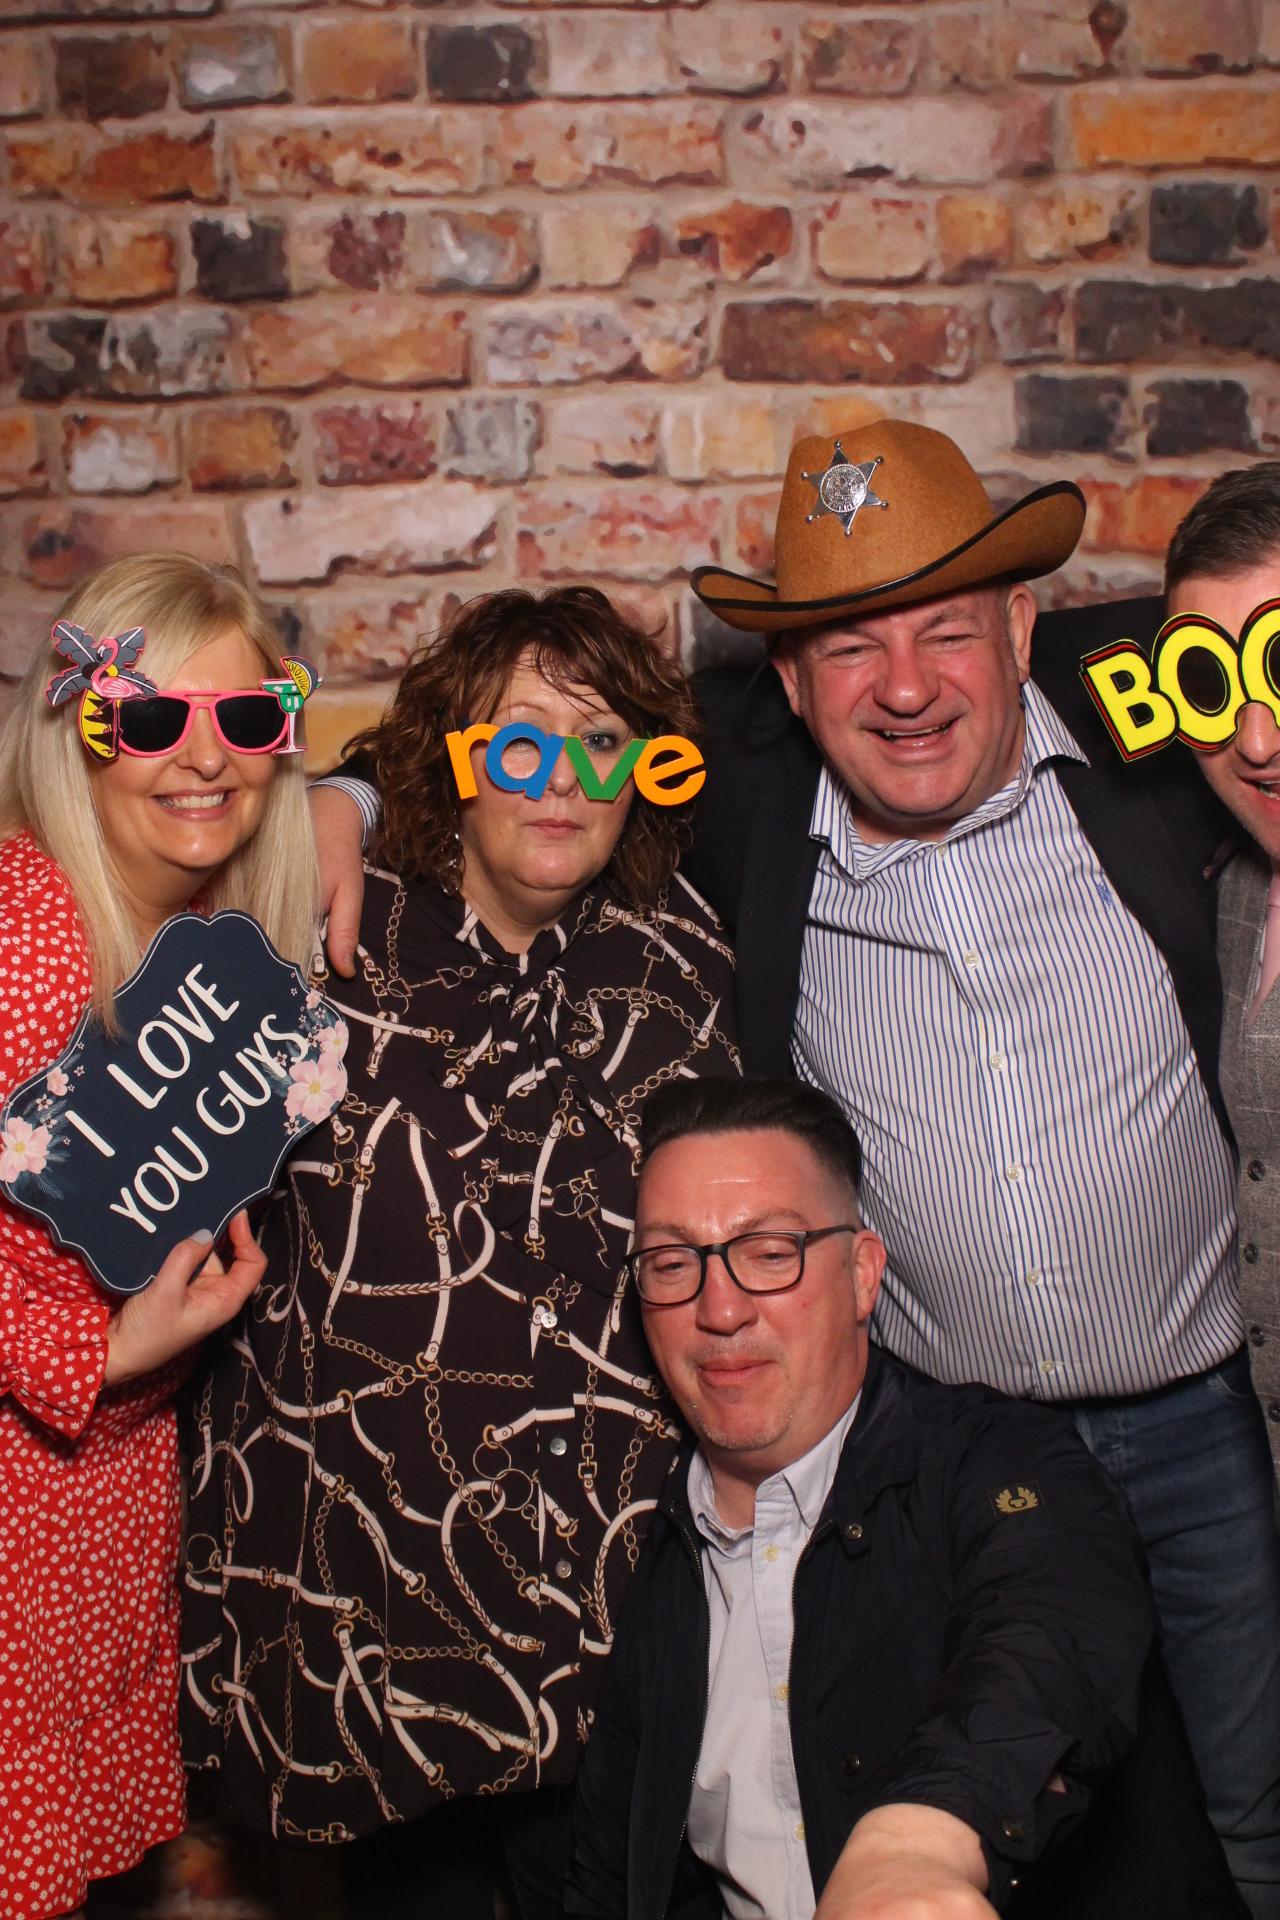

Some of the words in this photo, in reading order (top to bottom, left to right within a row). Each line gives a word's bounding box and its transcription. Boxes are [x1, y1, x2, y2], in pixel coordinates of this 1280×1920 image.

[445, 722, 706, 806] rave
[65, 1110, 115, 1157] I
[107, 963, 240, 1109] LOVE
[110, 1126, 209, 1233] YOU
[196, 1014, 309, 1135] GUYS
